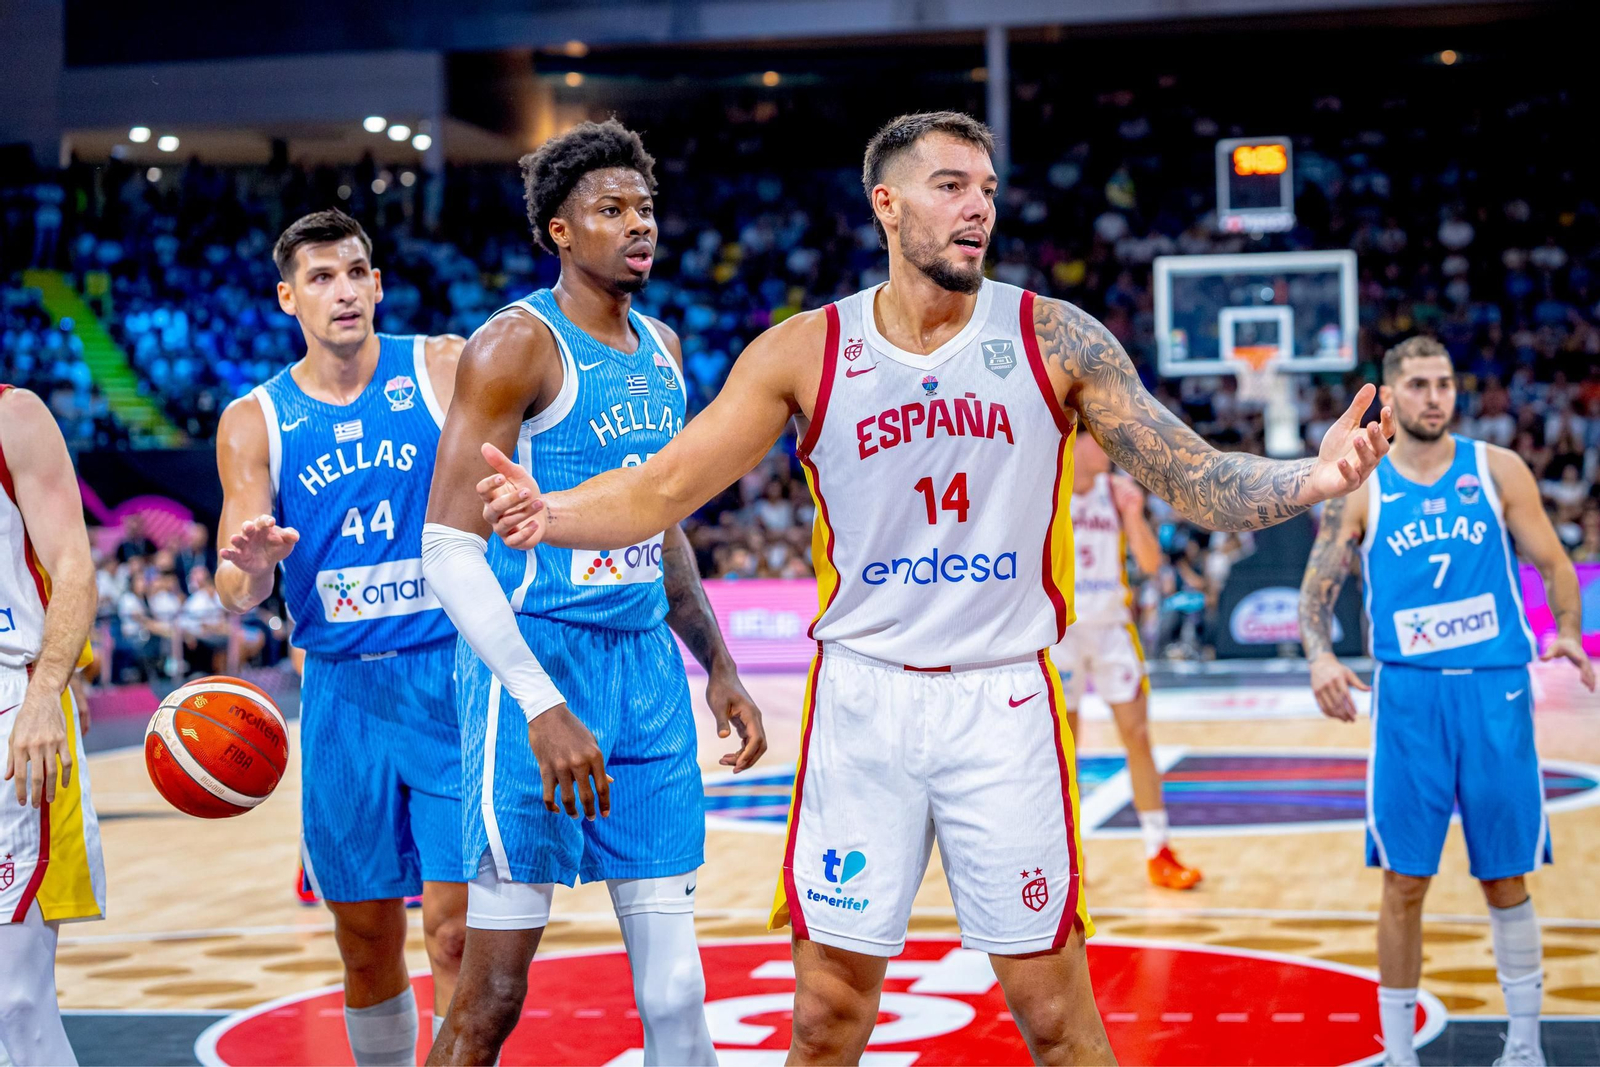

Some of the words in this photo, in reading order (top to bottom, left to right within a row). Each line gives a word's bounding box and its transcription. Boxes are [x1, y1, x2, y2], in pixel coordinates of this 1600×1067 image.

[856, 392, 1015, 460] ESPAÑA
[298, 440, 417, 496] HELLAS
[914, 472, 970, 524] 14
[341, 499, 395, 545] 44
[1386, 516, 1488, 557] HELLAS
[861, 547, 1017, 585] endesa
[1428, 553, 1451, 589] 7
[228, 705, 280, 748] molten
[223, 743, 254, 770] FIBA
